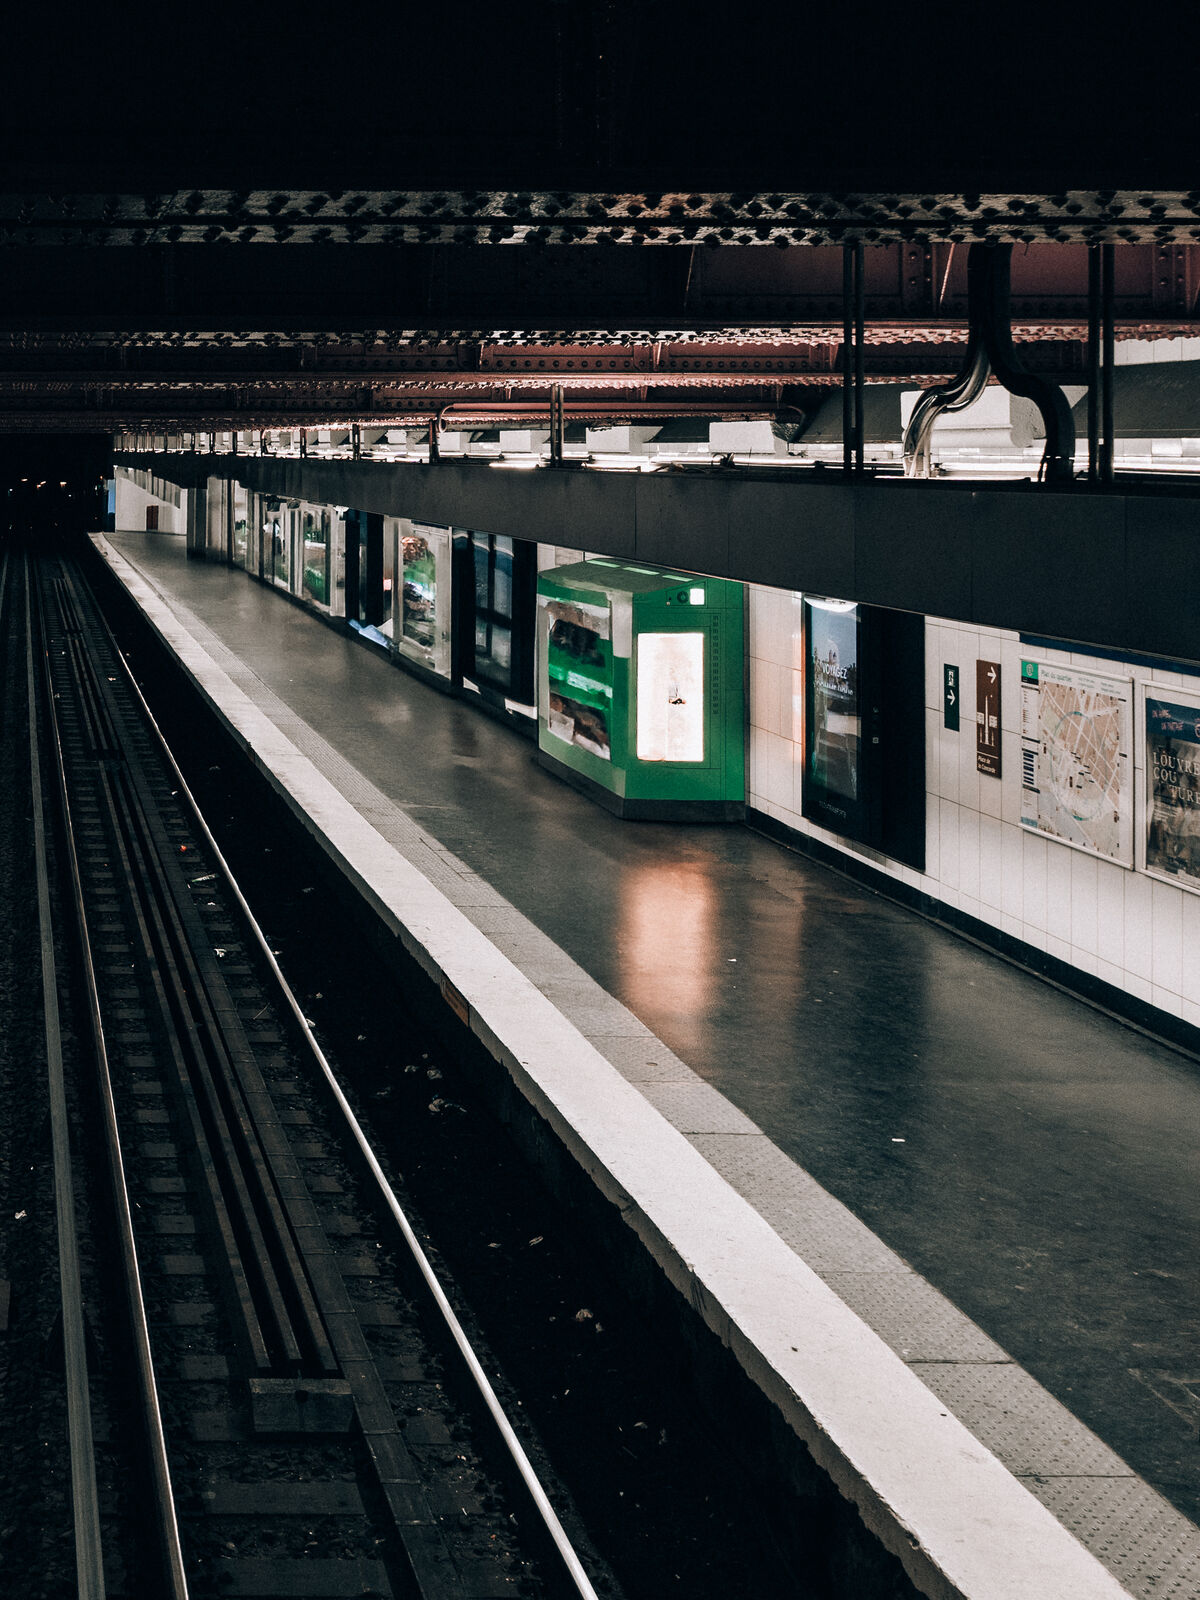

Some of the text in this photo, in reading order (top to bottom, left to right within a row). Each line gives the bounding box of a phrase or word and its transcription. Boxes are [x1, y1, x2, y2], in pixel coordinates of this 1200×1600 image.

[821, 661, 848, 680] VOYAGEZ
[1153, 752, 1200, 776] LOUVRE
[1153, 767, 1177, 783] COU
